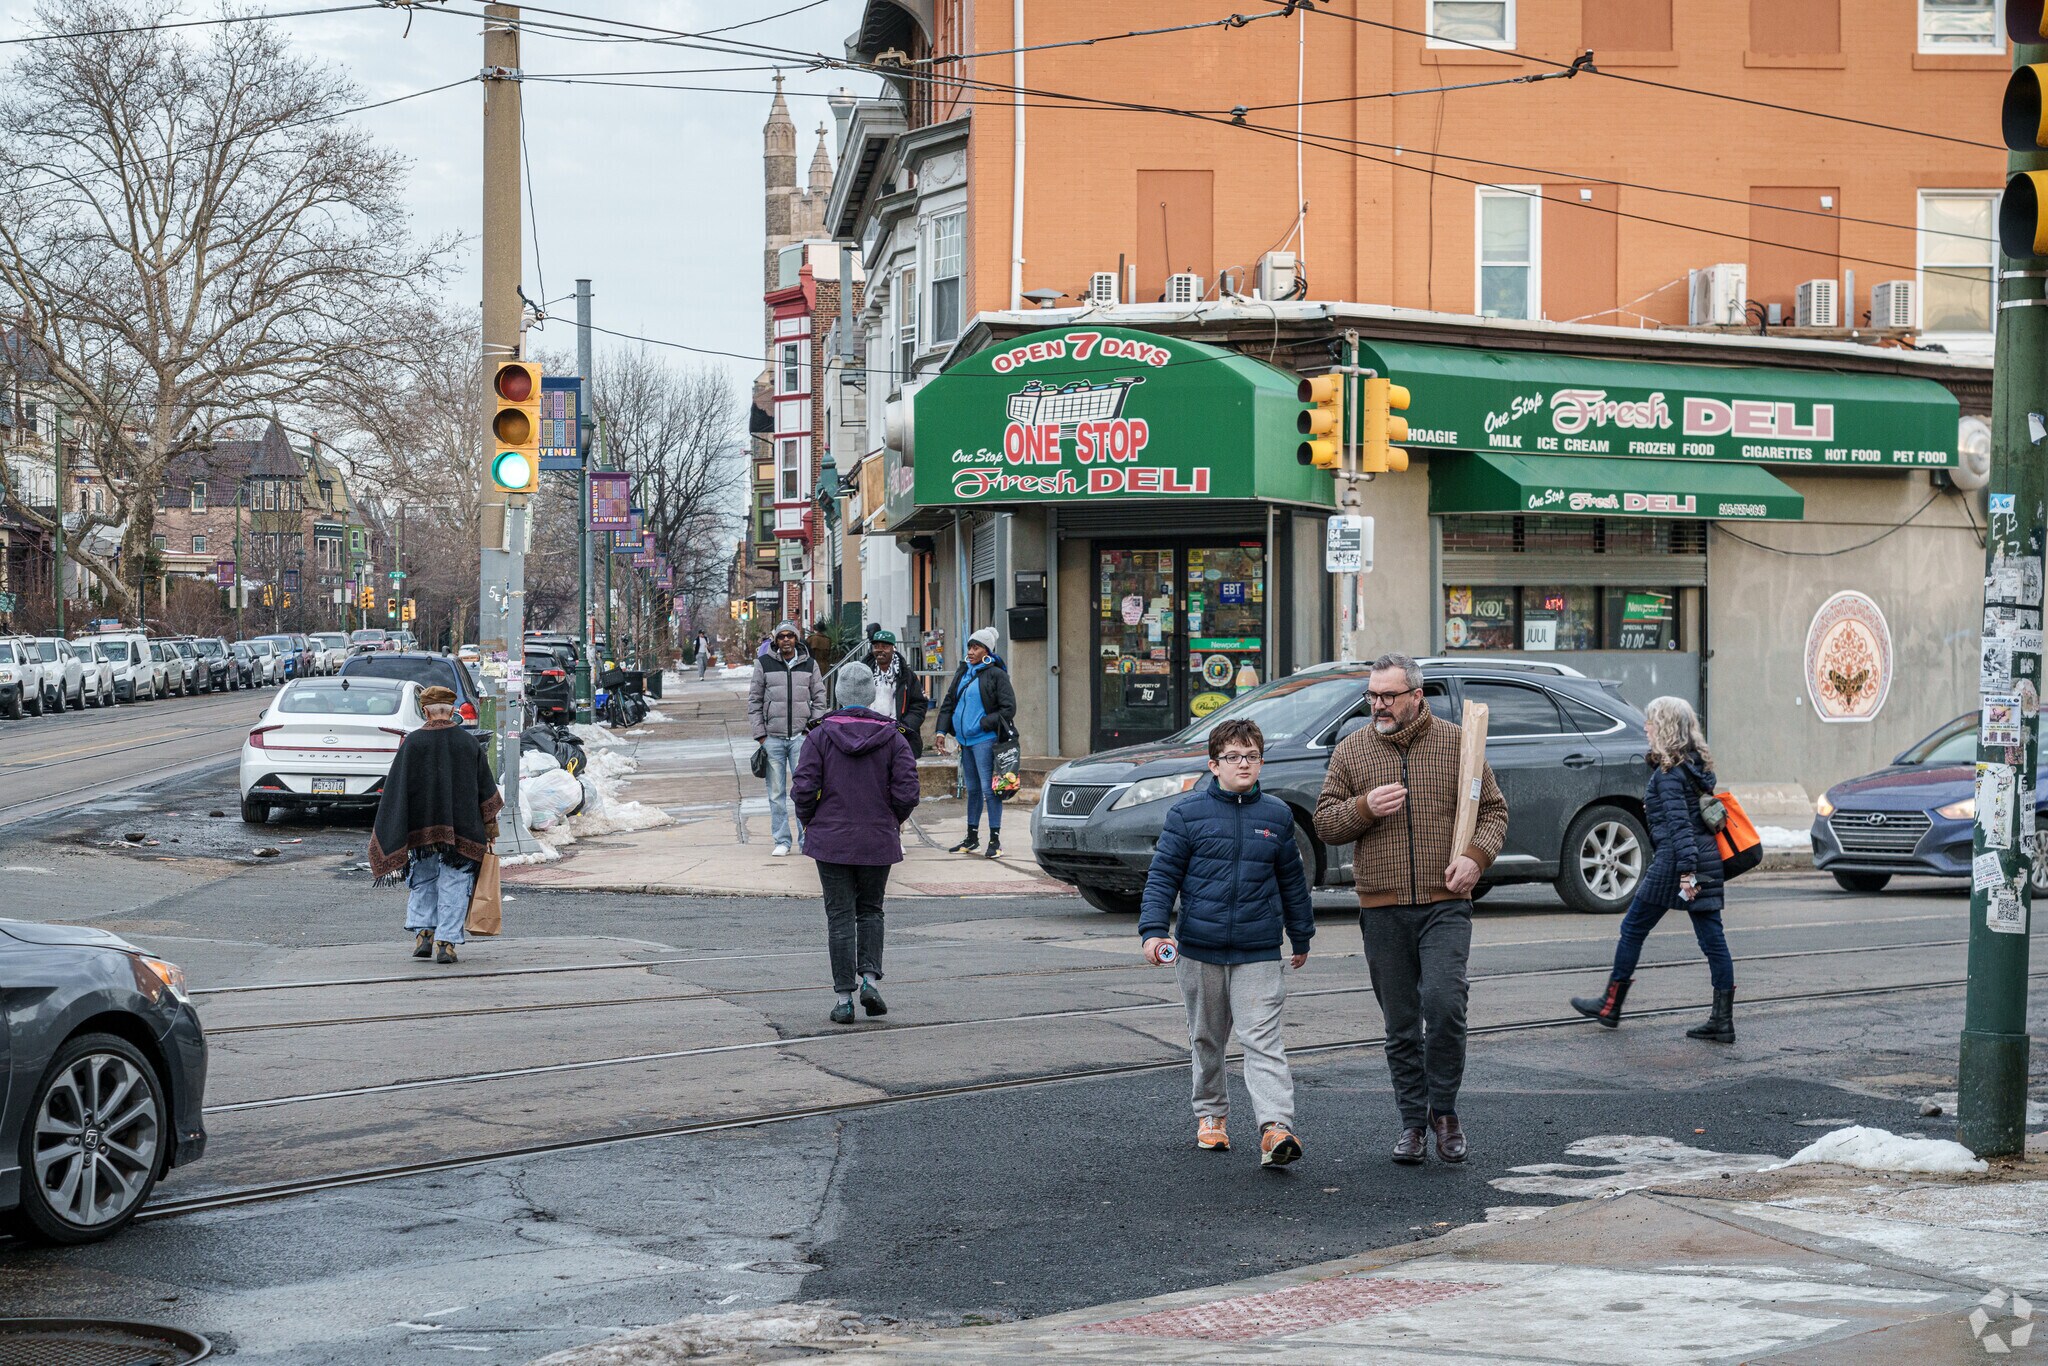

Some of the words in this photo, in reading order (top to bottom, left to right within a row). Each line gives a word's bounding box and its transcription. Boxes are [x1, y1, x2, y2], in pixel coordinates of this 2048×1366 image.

[992, 339, 1065, 373] OPEN
[1065, 332, 1102, 361] 7
[1101, 338, 1172, 368] DAYS
[1484, 411, 1509, 434] One
[1511, 392, 1544, 421] Stop
[1550, 389, 1674, 435] Fresh
[1683, 396, 1834, 441] DELI
[1004, 423, 1061, 465] ONE
[1075, 418, 1149, 463] STOP
[1407, 428, 1457, 444] HOAGIE
[1489, 434, 1522, 448] MILK
[1537, 436, 1558, 450] ICE
[1564, 438, 1610, 453] CREAM
[1629, 441, 1676, 456] FROZEN
[1682, 443, 1715, 456] FOOD
[1742, 445, 1813, 461] CIGARETTES
[1825, 448, 1848, 462] HOT
[1851, 448, 1881, 462] FOOD
[1893, 450, 1915, 463] PET
[1918, 451, 1947, 464] FOOD
[539, 448, 577, 457] VENUE
[952, 449, 973, 464] One
[975, 448, 1003, 465] Stop
[952, 467, 1085, 498] Fresh
[1087, 467, 1210, 494] DELI
[1528, 494, 1544, 510] One
[1545, 489, 1565, 505] Stop
[1568, 492, 1619, 511] Fresh
[1623, 492, 1696, 513] DELI
[1719, 503, 1767, 516] 215-727-0649
[1329, 529, 1341, 540] 64
[1223, 584, 1241, 595] EBT
[1475, 600, 1505, 617] KOOL
[1545, 598, 1563, 610] ATM
[1627, 601, 1658, 614] Newport
[1526, 628, 1547, 643] JUUL
[1620, 633, 1645, 649] $0.00
[1210, 641, 1240, 649] Newport
